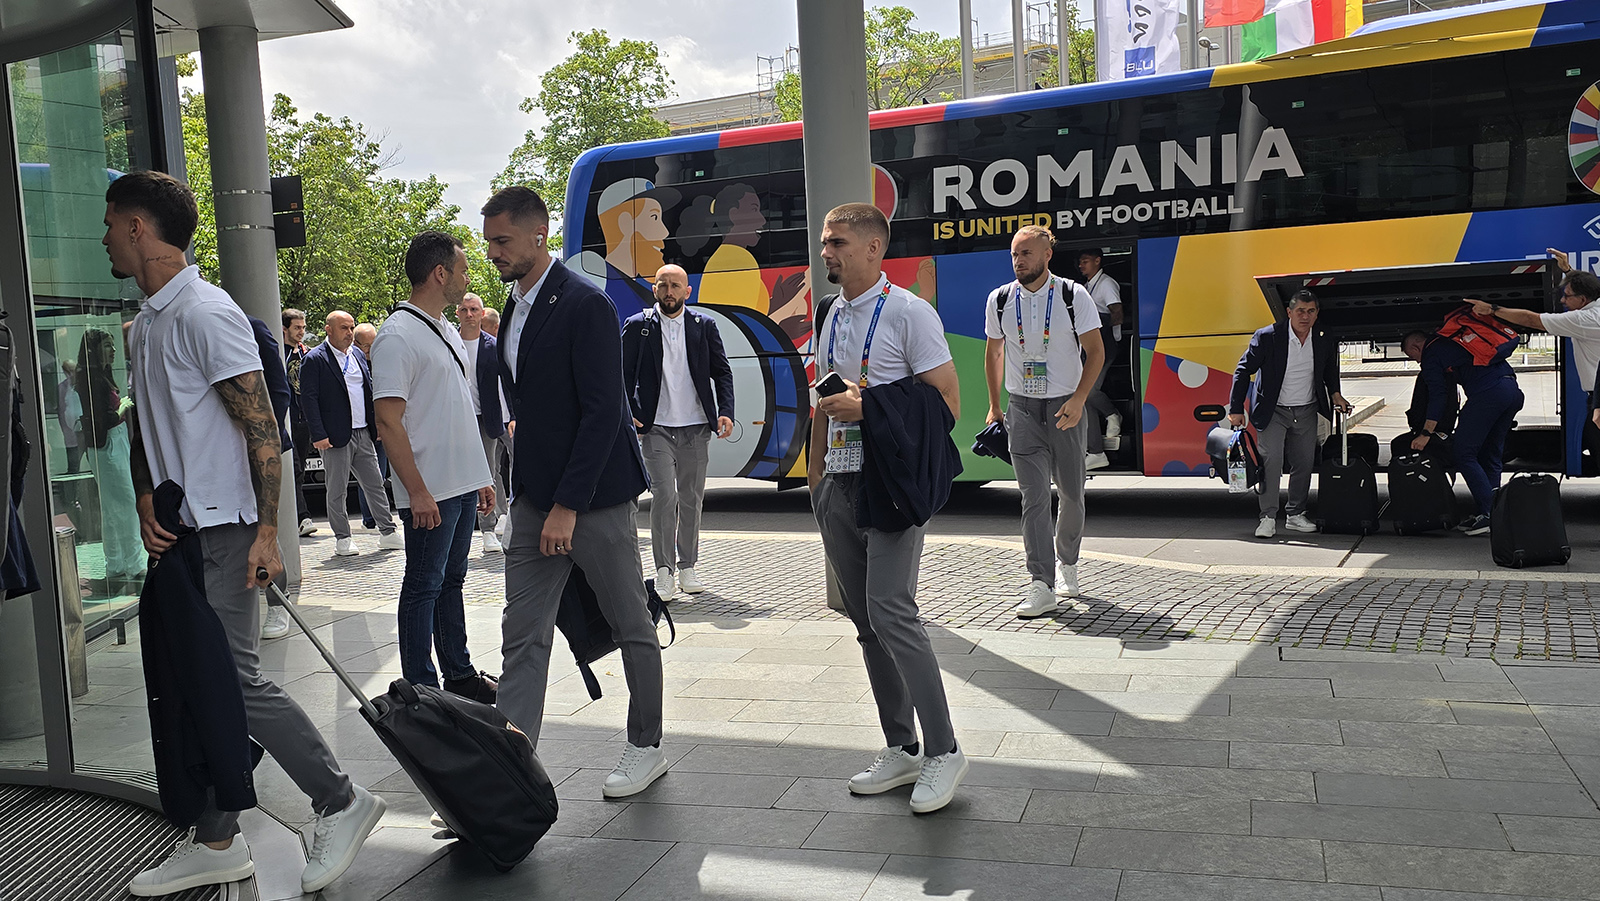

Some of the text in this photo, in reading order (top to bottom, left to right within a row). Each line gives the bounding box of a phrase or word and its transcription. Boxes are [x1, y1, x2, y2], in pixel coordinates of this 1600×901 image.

[1133, 0, 1152, 44] on
[1126, 60, 1153, 73] BLU
[932, 126, 1304, 213] ROMANIA
[933, 194, 1244, 240] IS UNITED BY FOOTBALL
